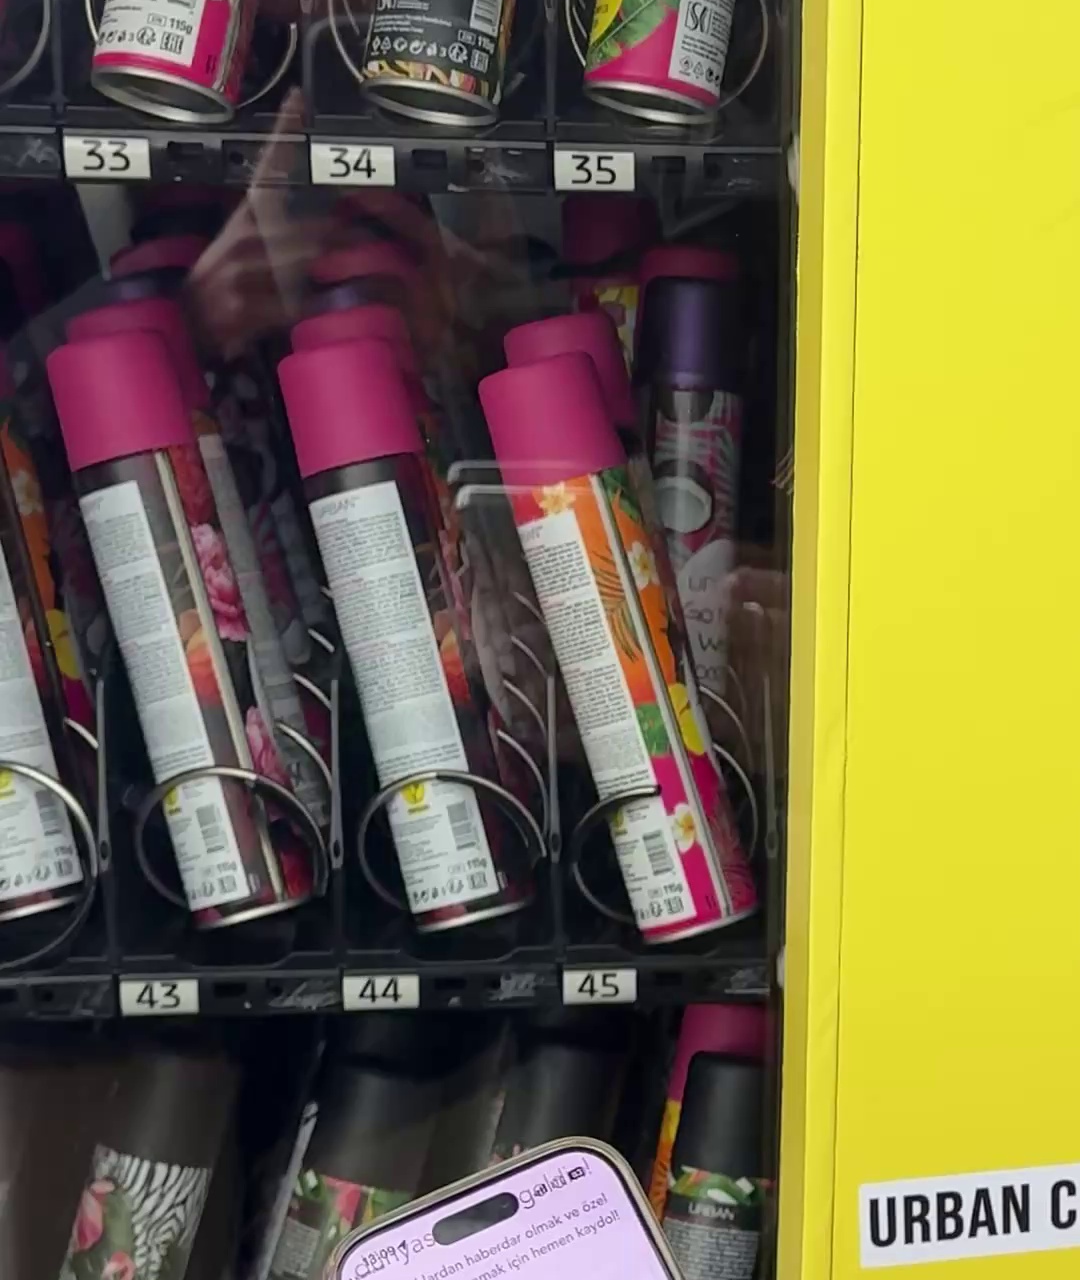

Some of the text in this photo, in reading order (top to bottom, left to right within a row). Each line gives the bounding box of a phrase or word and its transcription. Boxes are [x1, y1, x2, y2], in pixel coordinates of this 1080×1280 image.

[169, 18, 193, 35] 115g
[82, 139, 132, 171] 33
[328, 147, 377, 180] 34
[570, 154, 616, 186] 35
[135, 982, 182, 1009] 43
[358, 977, 403, 1003] 44
[576, 972, 621, 999] 45
[463, 1234, 521, 1267] haberdar
[525, 1215, 563, 1239] olmak
[563, 1208, 580, 1221] ve
[581, 1192, 608, 1213] özel
[868, 1183, 1031, 1248] URBAN
[507, 1253, 530, 1271] için
[530, 1233, 575, 1259] hemen
[574, 1209, 621, 1238] kaydol!
